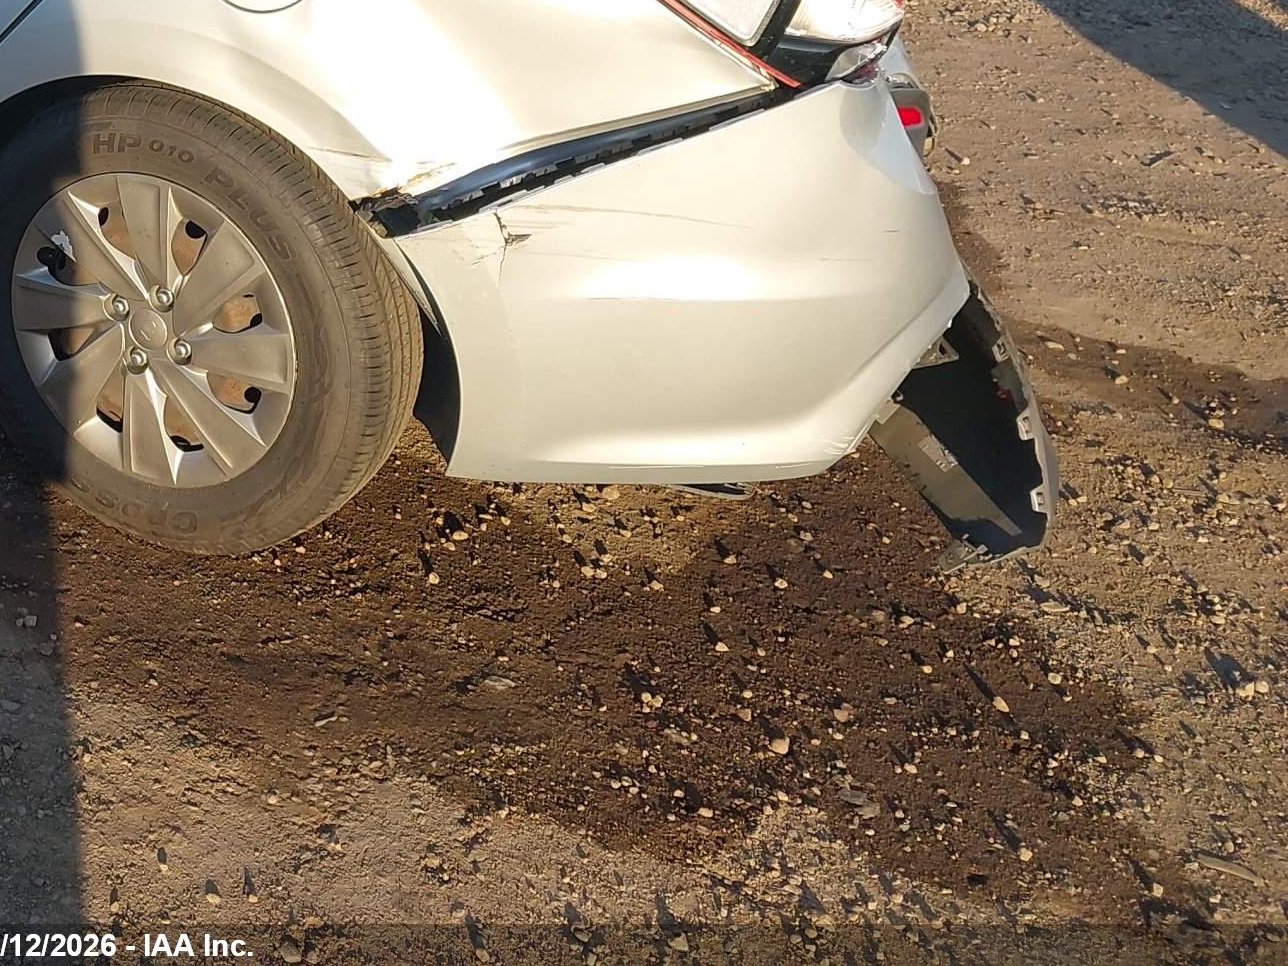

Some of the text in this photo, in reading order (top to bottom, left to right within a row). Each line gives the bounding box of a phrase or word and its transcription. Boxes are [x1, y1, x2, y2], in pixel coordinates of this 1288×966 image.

[91, 132, 297, 261] HP 010 PLUS
